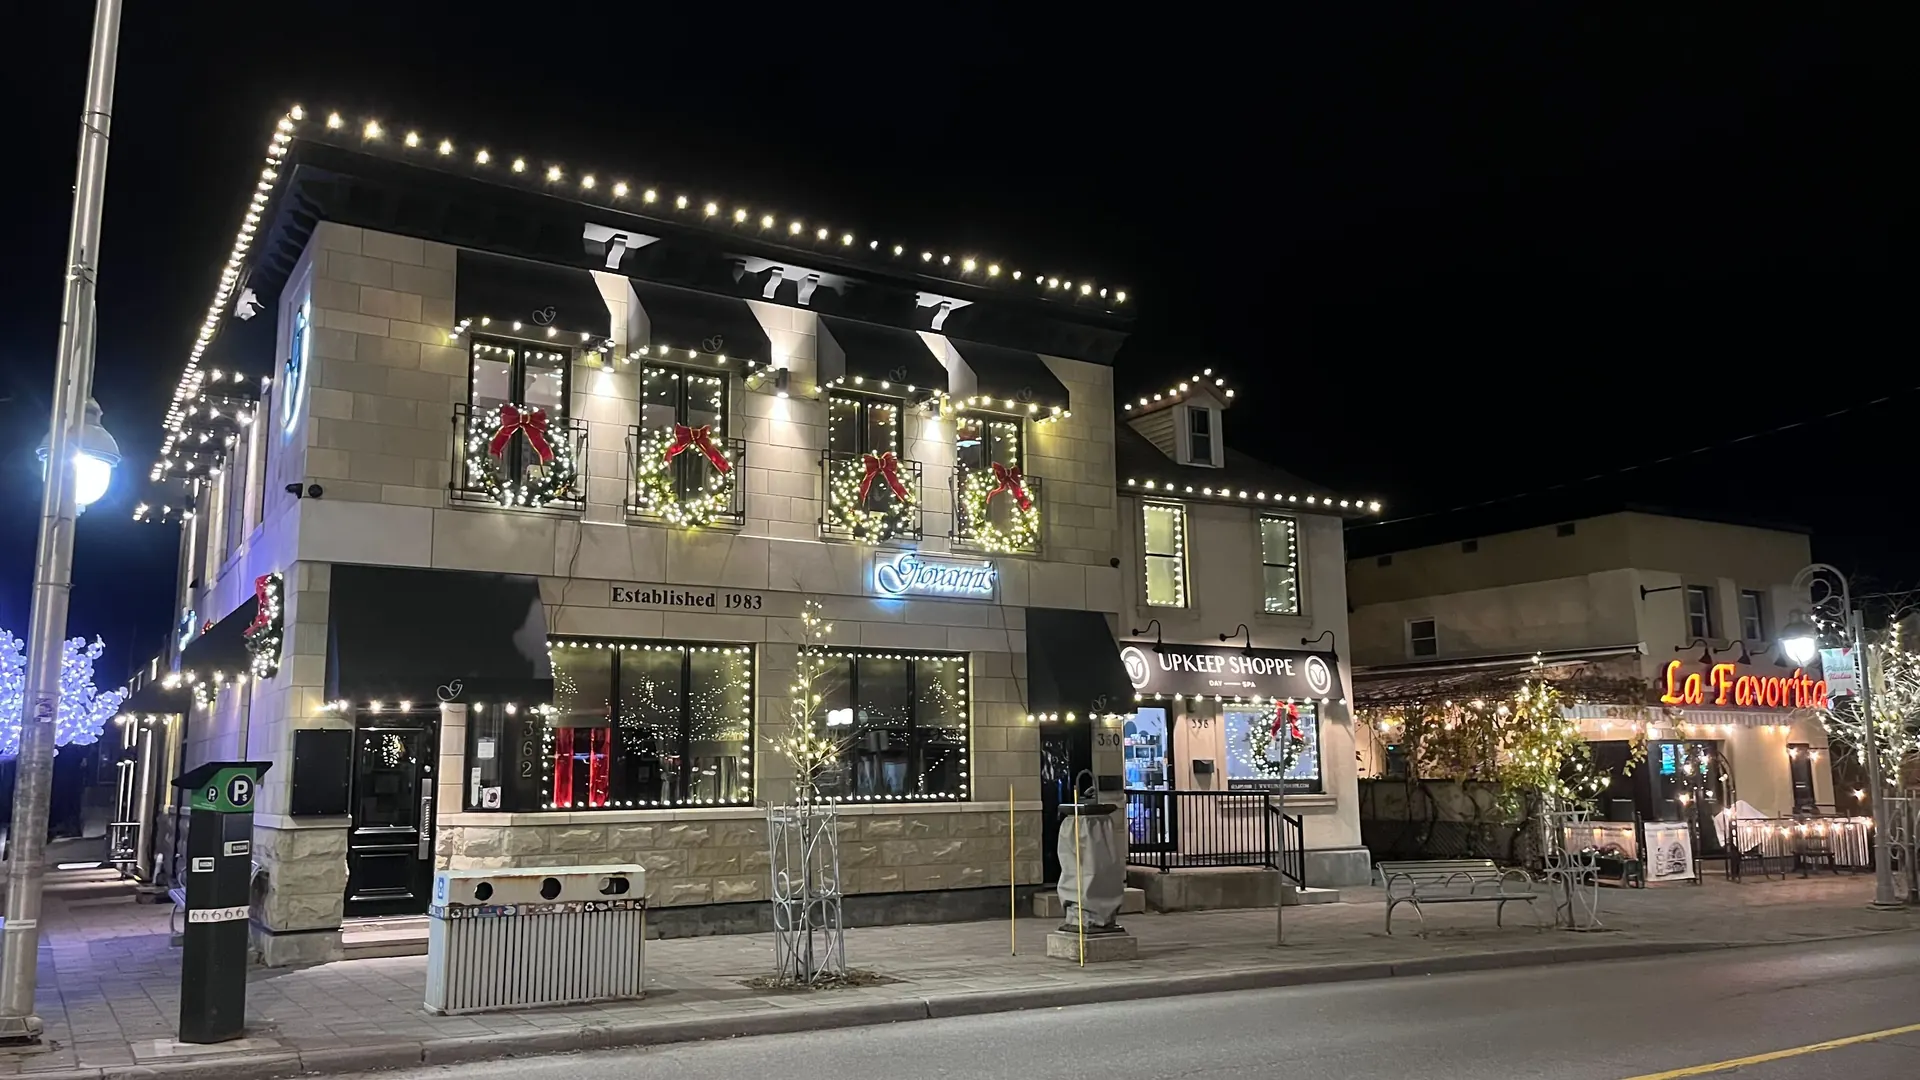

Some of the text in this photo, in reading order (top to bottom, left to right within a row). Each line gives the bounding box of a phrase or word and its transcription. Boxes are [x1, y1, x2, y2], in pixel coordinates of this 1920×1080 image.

[879, 553, 996, 594] Giovanni's
[611, 587, 763, 610] Established 1983
[1158, 652, 1296, 676] UPKEEP SHOPPE
[1208, 680, 1257, 688] DAY SPA
[1660, 659, 1704, 706] La
[1098, 733, 1120, 747] 360
